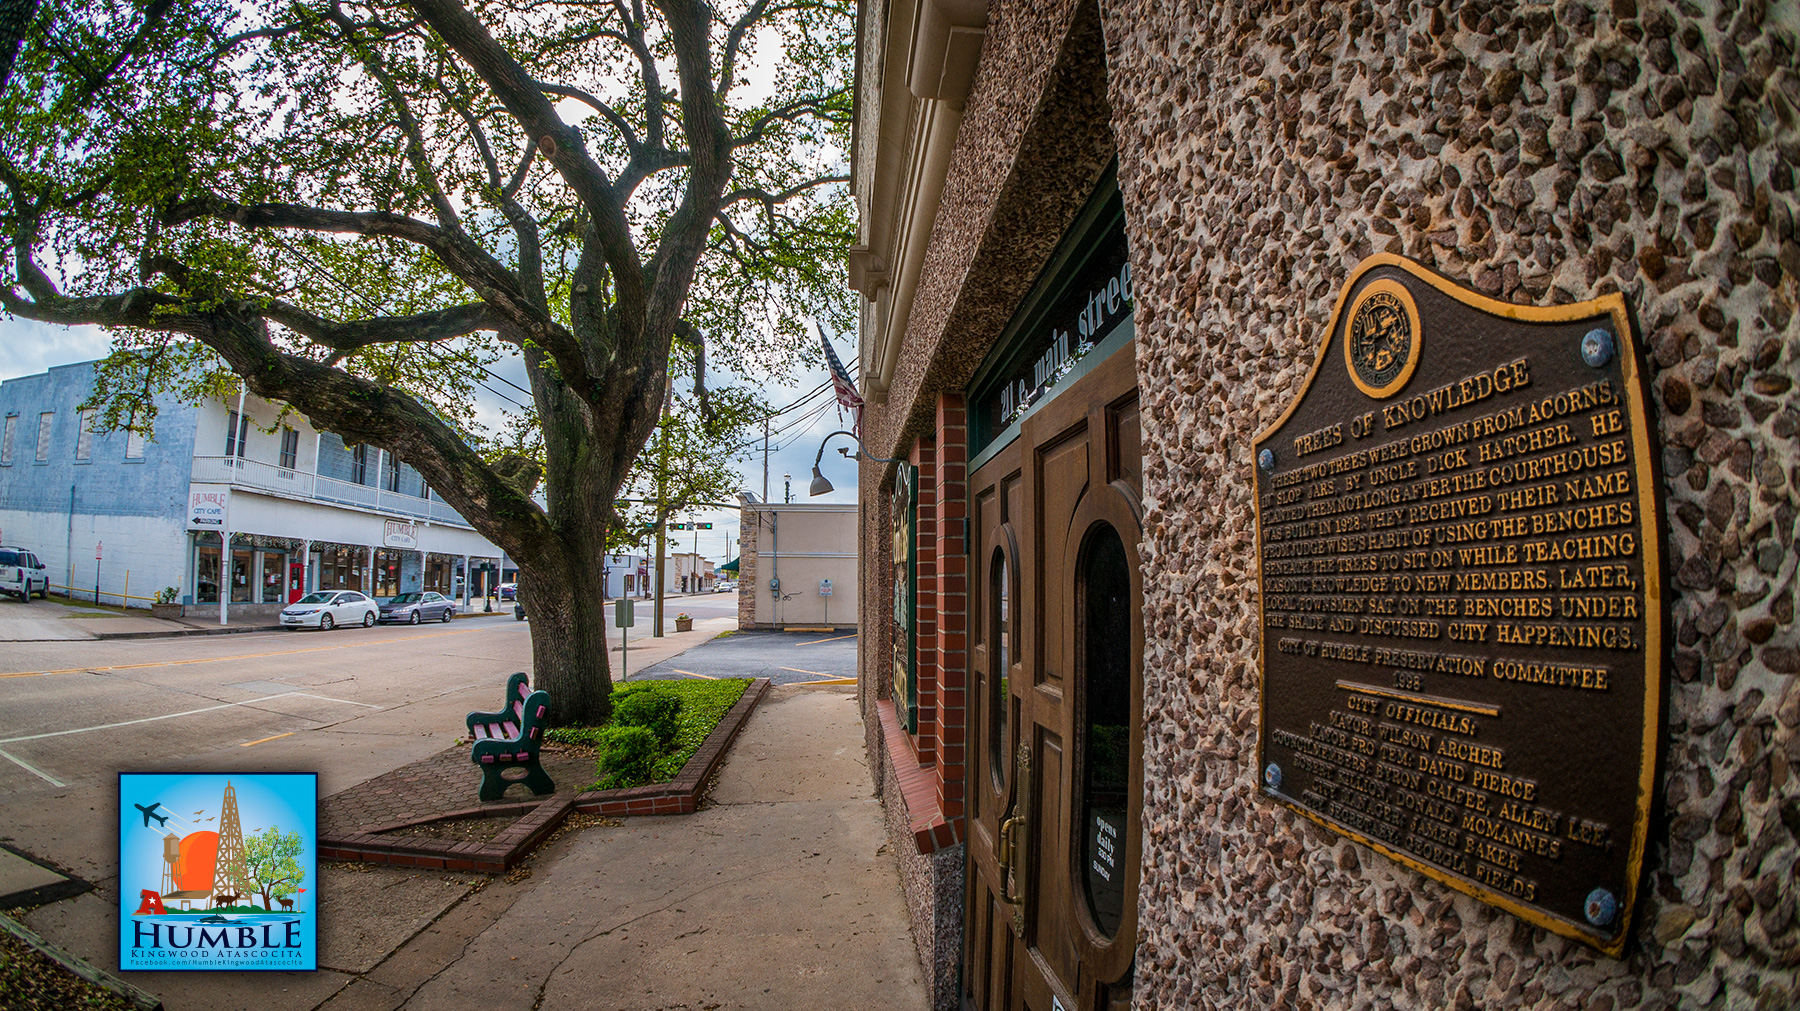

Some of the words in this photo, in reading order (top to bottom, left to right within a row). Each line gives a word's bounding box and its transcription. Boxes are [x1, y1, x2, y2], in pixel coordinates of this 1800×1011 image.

[1034, 328, 1069, 390] main
[1270, 467, 1302, 489] THESE
[1303, 461, 1327, 481] TWO
[1328, 450, 1367, 475] TREES
[1368, 438, 1409, 464] WERE
[1411, 420, 1469, 454] GROWN
[1472, 403, 1525, 439] FROM
[1528, 380, 1620, 424] ACORNS,
[1294, 423, 1343, 457] TREES
[1350, 411, 1374, 439] OF
[1383, 358, 1530, 430] KNOWLEDGE
[1261, 493, 1274, 508] IN
[1277, 487, 1302, 505] SLOP
[1345, 473, 1362, 491] BY
[1369, 461, 1417, 486] UNCLE
[1427, 448, 1469, 474] DICK
[1478, 423, 1577, 463] HATCHER.
[1591, 409, 1624, 438] HE
[1261, 506, 1304, 525] PLANTED
[1304, 501, 1336, 518] THEM
[1336, 495, 1362, 514] NOT
[1363, 487, 1400, 509] LONG
[1402, 476, 1454, 502] AFTER
[1453, 470, 1488, 494] THE
[1489, 440, 1627, 486] COURTHOUSE
[192, 493, 225, 509] HUMBLE
[386, 522, 416, 540] HUMBLE
[1263, 527, 1282, 542] WAS
[1285, 523, 1316, 539] BUILT
[1319, 519, 1331, 535] IN
[1367, 508, 1404, 529] THEY
[1409, 495, 1492, 524] RECEIVED
[1497, 484, 1559, 511] THEIR
[1565, 470, 1631, 501] NAME
[1263, 544, 1290, 559] FROM
[1289, 540, 1325, 557] JUDGE
[1326, 534, 1366, 553] WISE'S
[1412, 528, 1432, 547] OF
[1435, 521, 1488, 543] USING
[1491, 516, 1529, 539] THE
[1531, 501, 1633, 535] BENCHES
[1264, 560, 1311, 575] BENEATH
[1313, 559, 1335, 573] THE
[1337, 554, 1377, 572] TREES
[1380, 553, 1399, 570] TO
[1402, 551, 1427, 569] SIT
[1431, 550, 1453, 568] ON
[1458, 545, 1518, 566] WHILE
[1523, 533, 1635, 563] TEACHING
[1265, 577, 1309, 593] MASONIC
[1311, 576, 1389, 593] KNOWLEDGE
[1392, 575, 1411, 592] TO
[1415, 573, 1451, 592] NEW
[1456, 569, 1553, 592] MEMBERS.
[1560, 565, 1637, 592] LATER,
[1265, 596, 1296, 611] LOCAL
[1299, 597, 1365, 613] TOWNSMEN
[1368, 597, 1395, 614] SAT
[1400, 597, 1420, 615] ON
[1425, 598, 1458, 616] THE
[1464, 597, 1552, 617] BENCHES
[1560, 595, 1638, 618] UNDER
[1266, 613, 1285, 627] THE
[1289, 614, 1325, 630] SHADE
[1329, 616, 1354, 632] AND
[1360, 618, 1440, 639] DISCUSSED
[1448, 622, 1488, 642] CITY
[1278, 637, 1301, 654] CITY
[1303, 640, 1319, 656] OF
[1321, 642, 1370, 663] HUMBLE
[1374, 647, 1486, 677] PRESERVATION
[1493, 660, 1609, 690] COMMITTEE
[1329, 710, 1373, 736] MAYOR:
[1378, 722, 1431, 751] WILSON
[1437, 736, 1504, 769] ARCHER
[1347, 695, 1380, 714] CITY
[1386, 701, 1476, 736] OFFICIALS:
[1309, 722, 1347, 748] MAYOR
[1351, 735, 1376, 756] PRO
[1380, 742, 1413, 767] TEM:
[1419, 755, 1465, 782] DAVID
[1472, 770, 1537, 801] PIERCE
[1096, 816, 1116, 838] opens
[1293, 752, 1335, 780] ROBERT
[1396, 789, 1454, 824] DONALD
[1461, 813, 1561, 859] MCMANNES
[1312, 777, 1339, 800] CITY
[1409, 815, 1457, 846] JAMES
[1465, 836, 1520, 872] BAKER
[1375, 761, 1421, 790] BYRON
[1427, 779, 1492, 817] CALFEE,
[1499, 801, 1562, 834] ALLEN
[1301, 789, 1328, 813] CITY
[1404, 832, 1469, 875] GEORGIA
[1476, 862, 1536, 902] FIELDS
